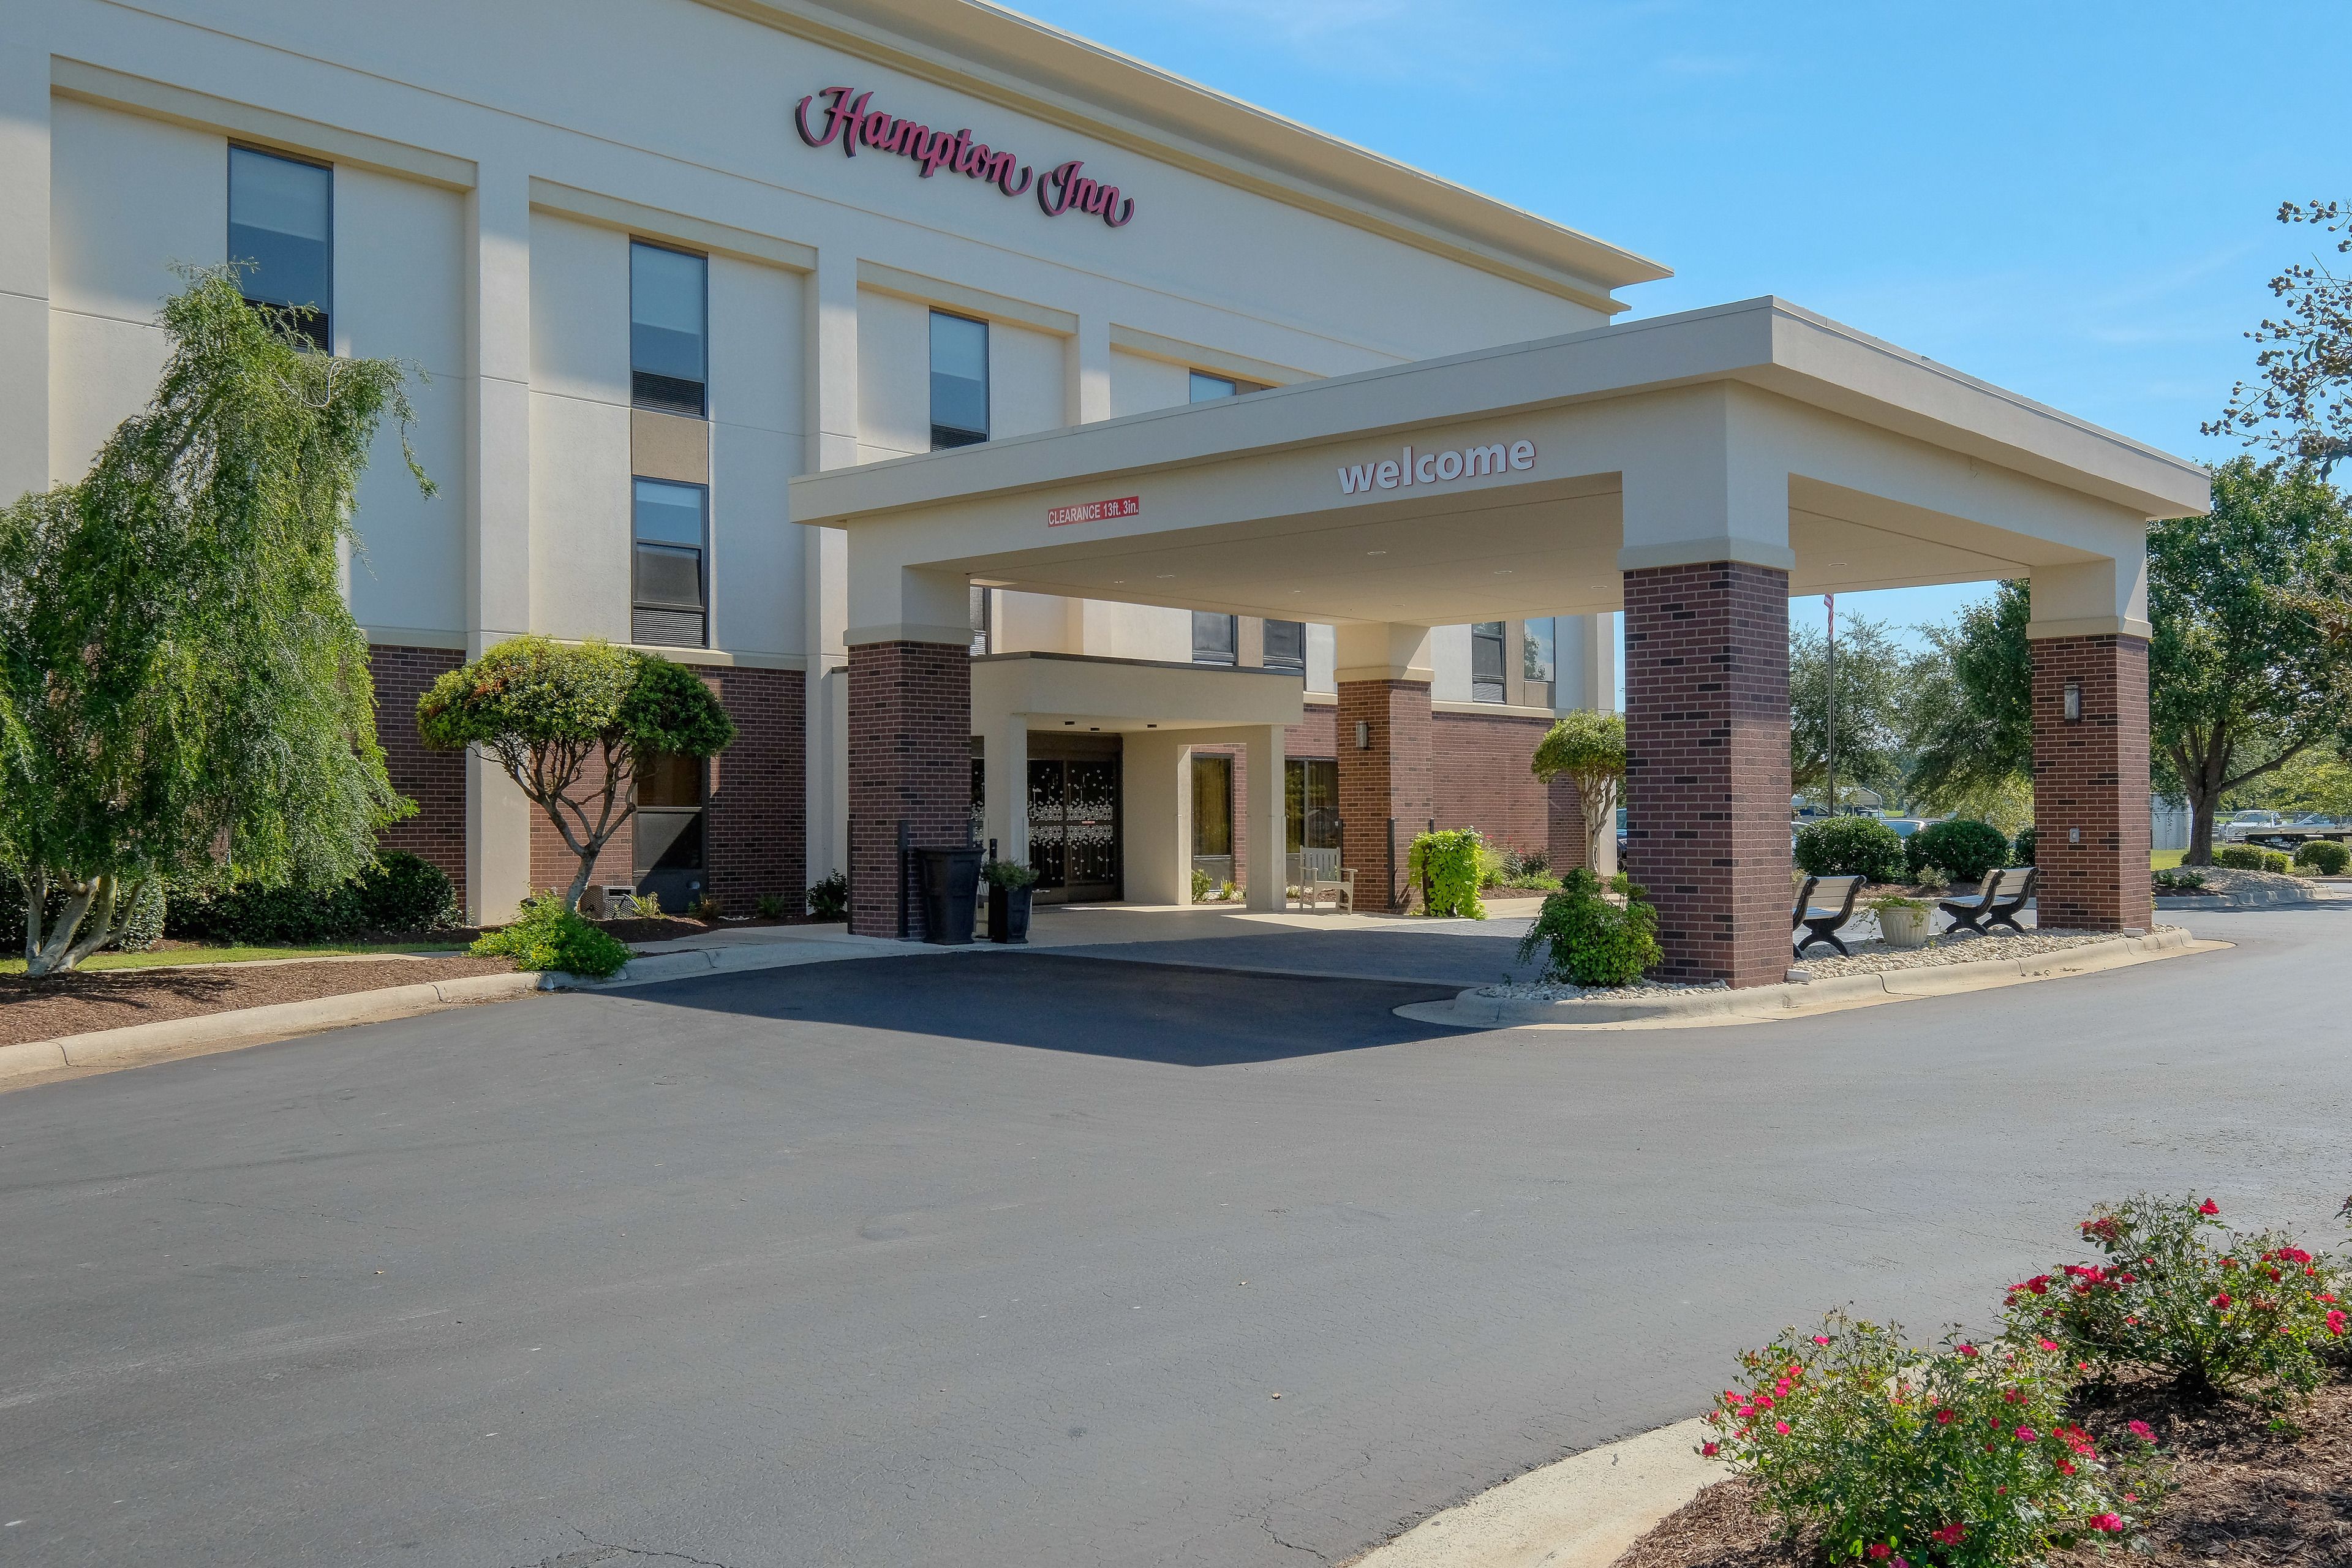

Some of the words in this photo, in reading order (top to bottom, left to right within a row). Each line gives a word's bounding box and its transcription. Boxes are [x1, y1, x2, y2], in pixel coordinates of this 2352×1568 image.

[794, 86, 1033, 197] Hampton
[1036, 160, 1136, 228] Inn
[1337, 439, 1536, 495] welcome
[1048, 504, 1101, 525] CLEARANCE
[1103, 501, 1121, 517] 13ft.
[1123, 500, 1139, 514] 3in.
